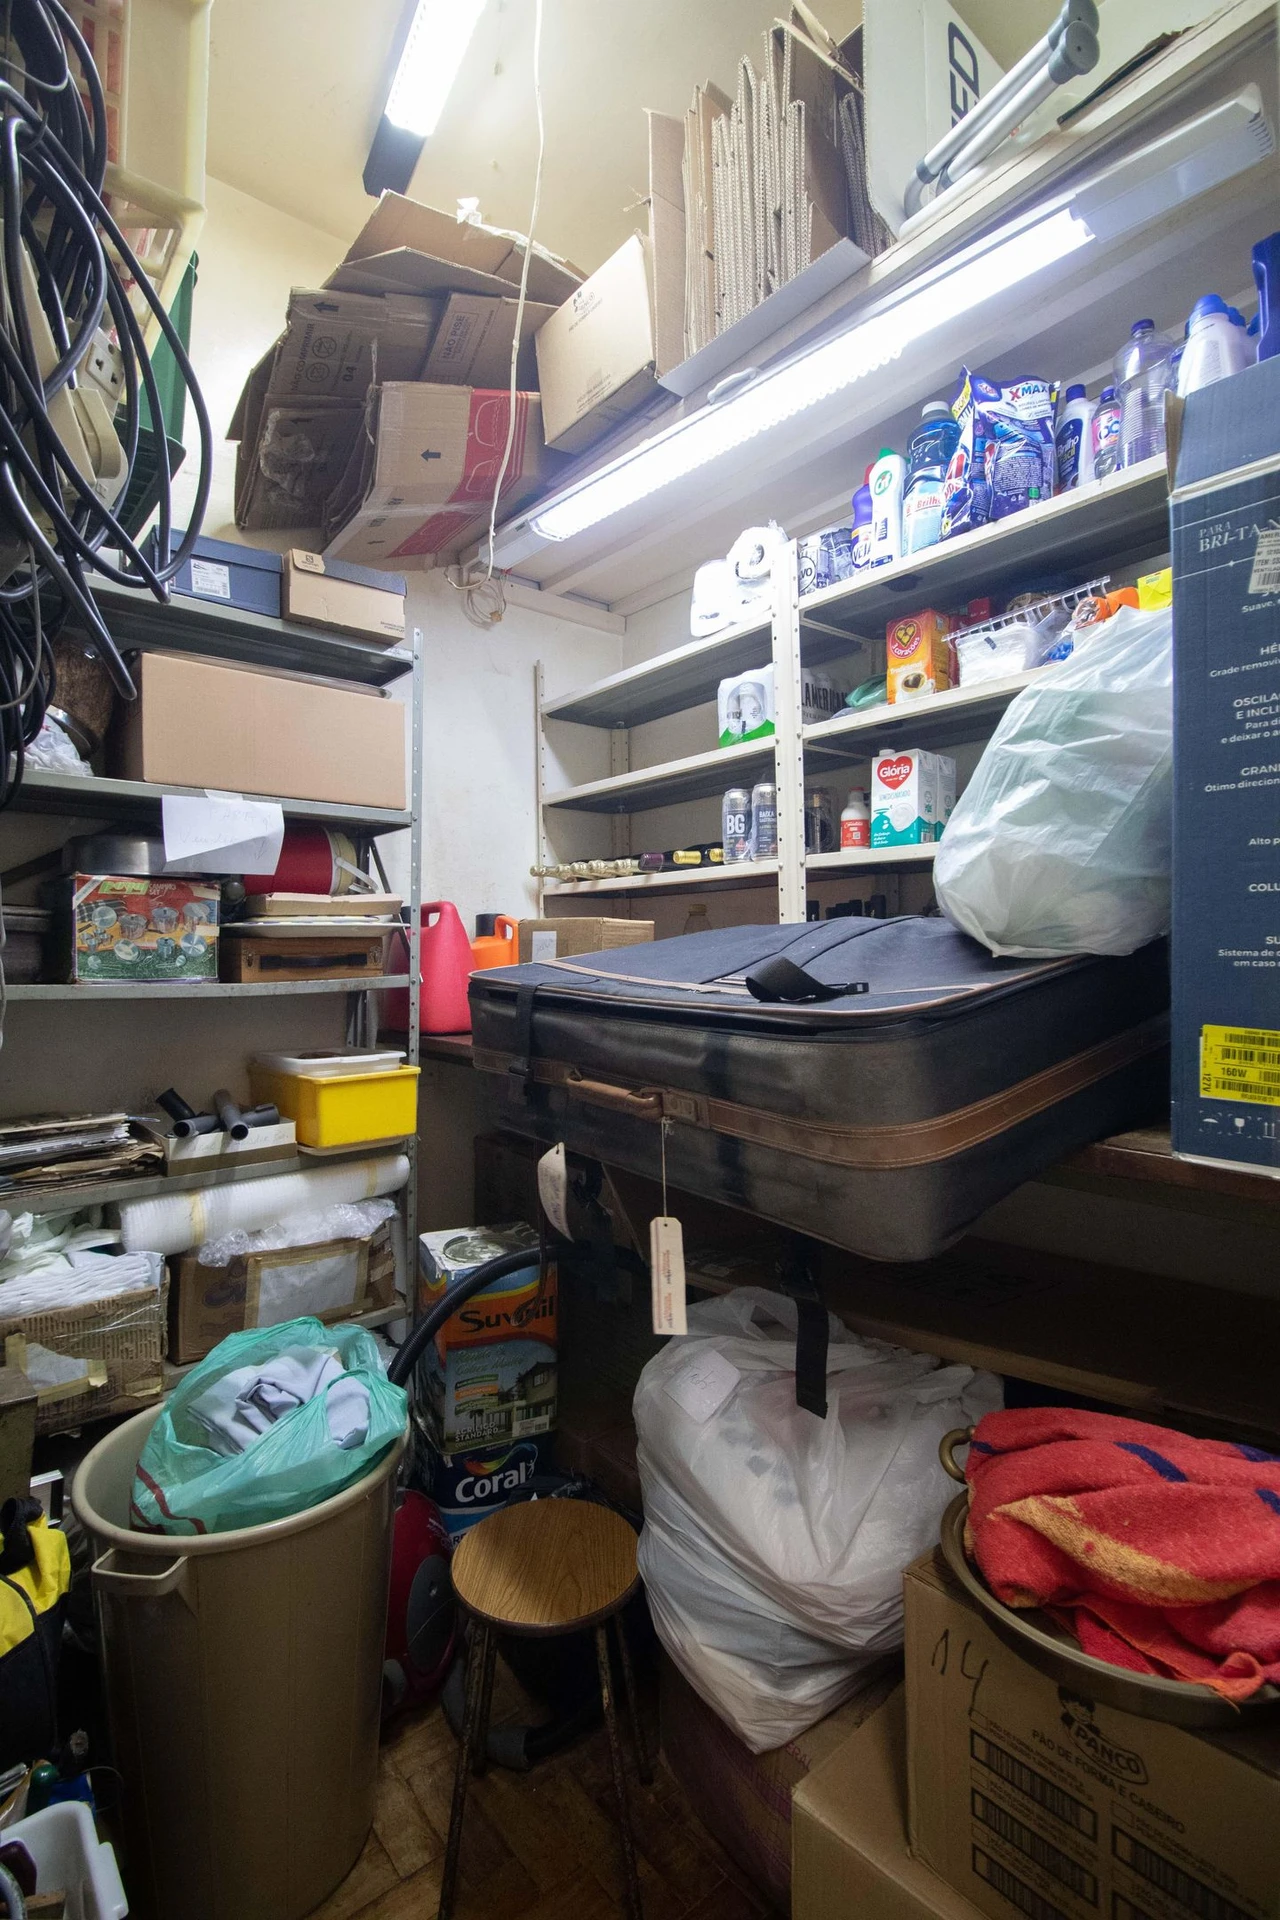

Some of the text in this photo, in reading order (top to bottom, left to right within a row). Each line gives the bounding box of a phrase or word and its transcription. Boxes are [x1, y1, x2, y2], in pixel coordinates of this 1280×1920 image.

[1199, 521, 1231, 538] PARA
[1210, 667, 1239, 678] Grade
[1233, 692, 1280, 708] OSCILA
[1236, 710, 1244, 720] E
[1245, 721, 1269, 730] Para
[1229, 733, 1261, 744] deixar
[880, 763, 910, 778] Glória
[1204, 782, 1236, 793] Ótimo
[726, 814, 745, 835] BG
[1248, 837, 1271, 846] Alto
[1218, 948, 1274, 957] Sistema de
[1252, 959, 1276, 967] caso
[1221, 1067, 1247, 1078] 160W
[1203, 1073, 1211, 1093] 127V
[454, 1427, 499, 1442] STANDARD
[455, 1461, 526, 1503] Coral
[1076, 1726, 1141, 1776] PANCO
[1032, 1729, 1056, 1750] PÃO
[1076, 1757, 1117, 1789] FORMA
[1129, 1792, 1186, 1834] CASEIRO
